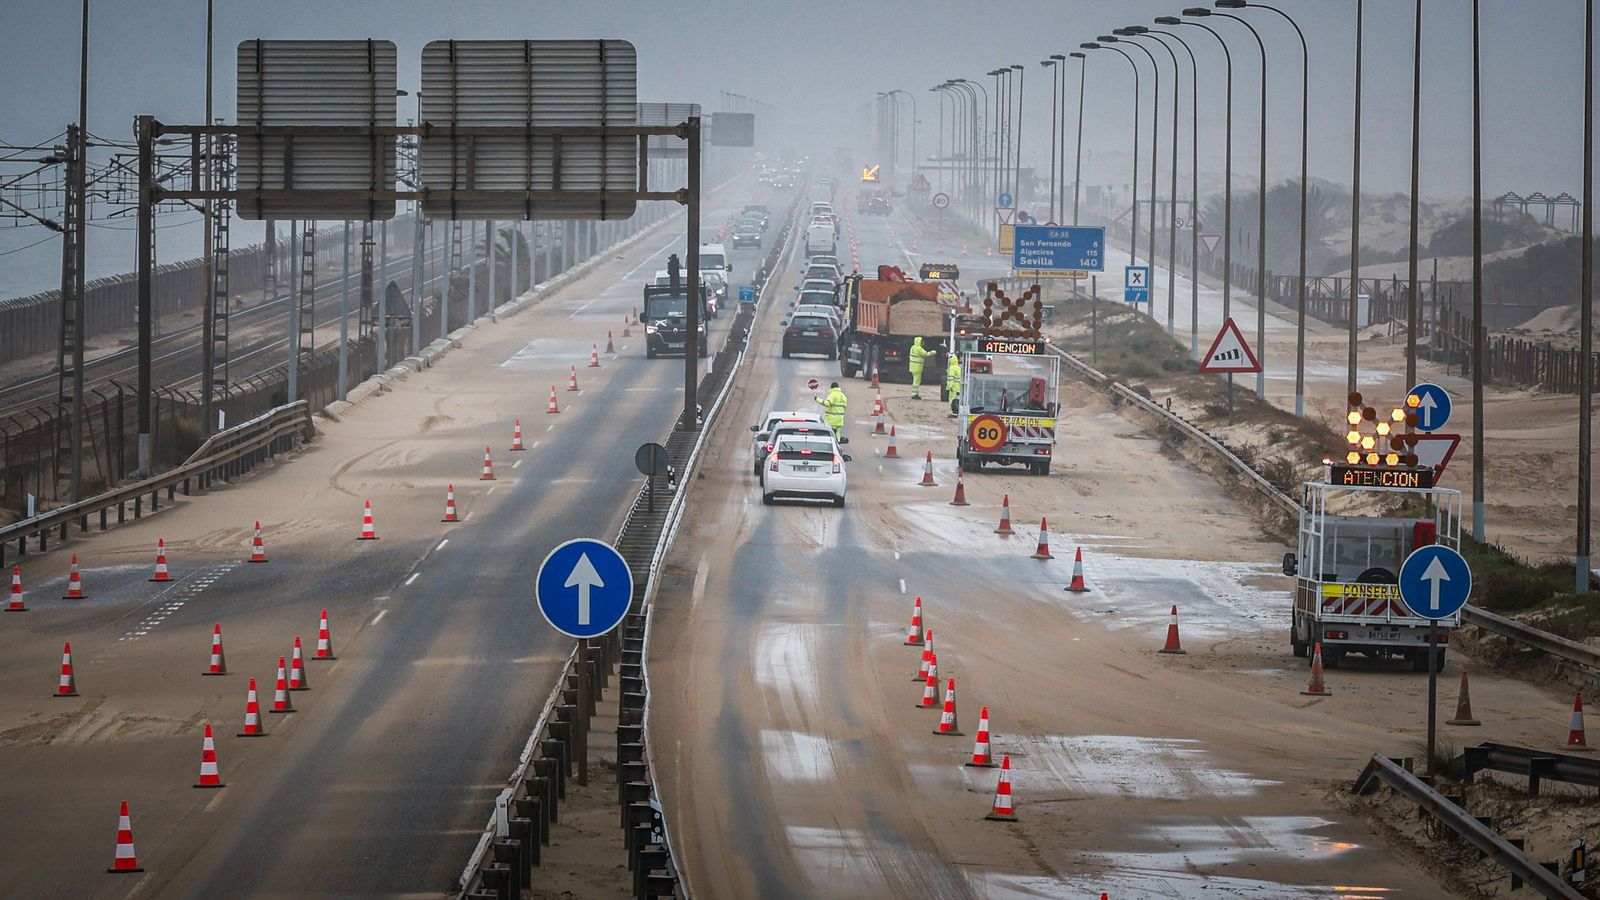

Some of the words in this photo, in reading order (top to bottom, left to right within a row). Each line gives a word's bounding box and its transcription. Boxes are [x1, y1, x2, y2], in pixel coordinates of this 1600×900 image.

[1020, 257, 1054, 266] Sevilla
[1080, 258, 1098, 267] 140
[986, 342, 1036, 354] ATENCION
[978, 427, 998, 441] 80
[1344, 470, 1418, 487] ATENCION
[1343, 584, 1400, 599] CONSERV
